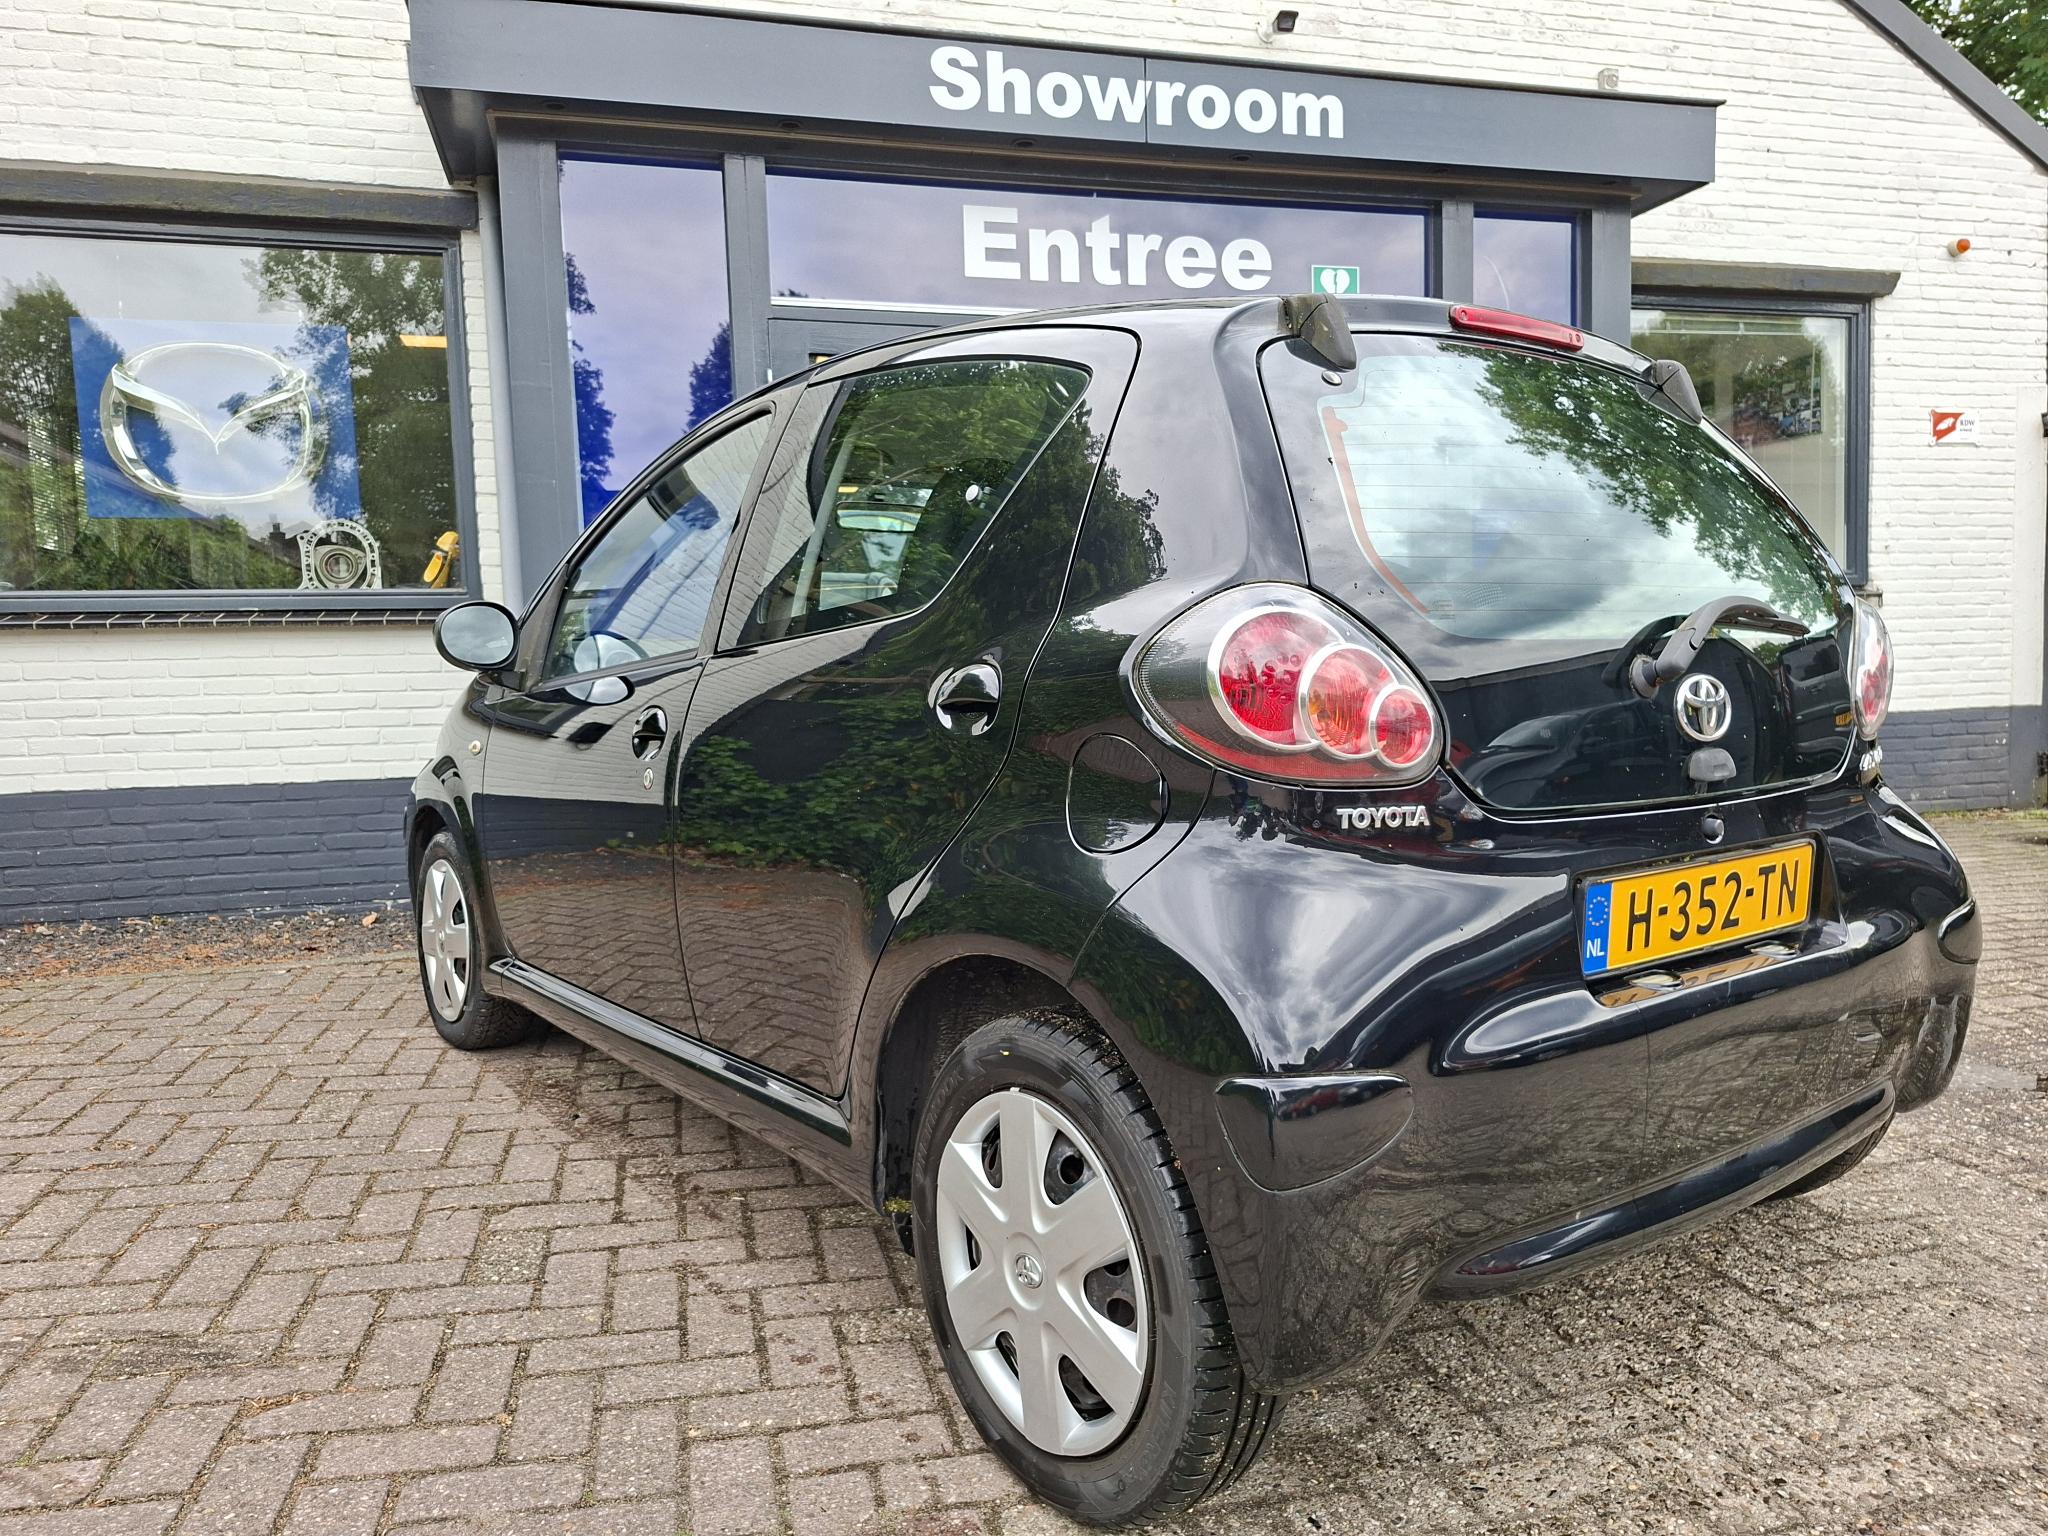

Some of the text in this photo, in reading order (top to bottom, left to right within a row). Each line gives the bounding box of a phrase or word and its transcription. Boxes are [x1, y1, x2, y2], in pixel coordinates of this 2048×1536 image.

[929, 45, 1344, 139] Showroom
[963, 205, 1273, 291] Entree
[1336, 805, 1430, 830] TOYOTA
[1626, 858, 1800, 952] H-352-TN
[1586, 939, 1604, 959] NL
